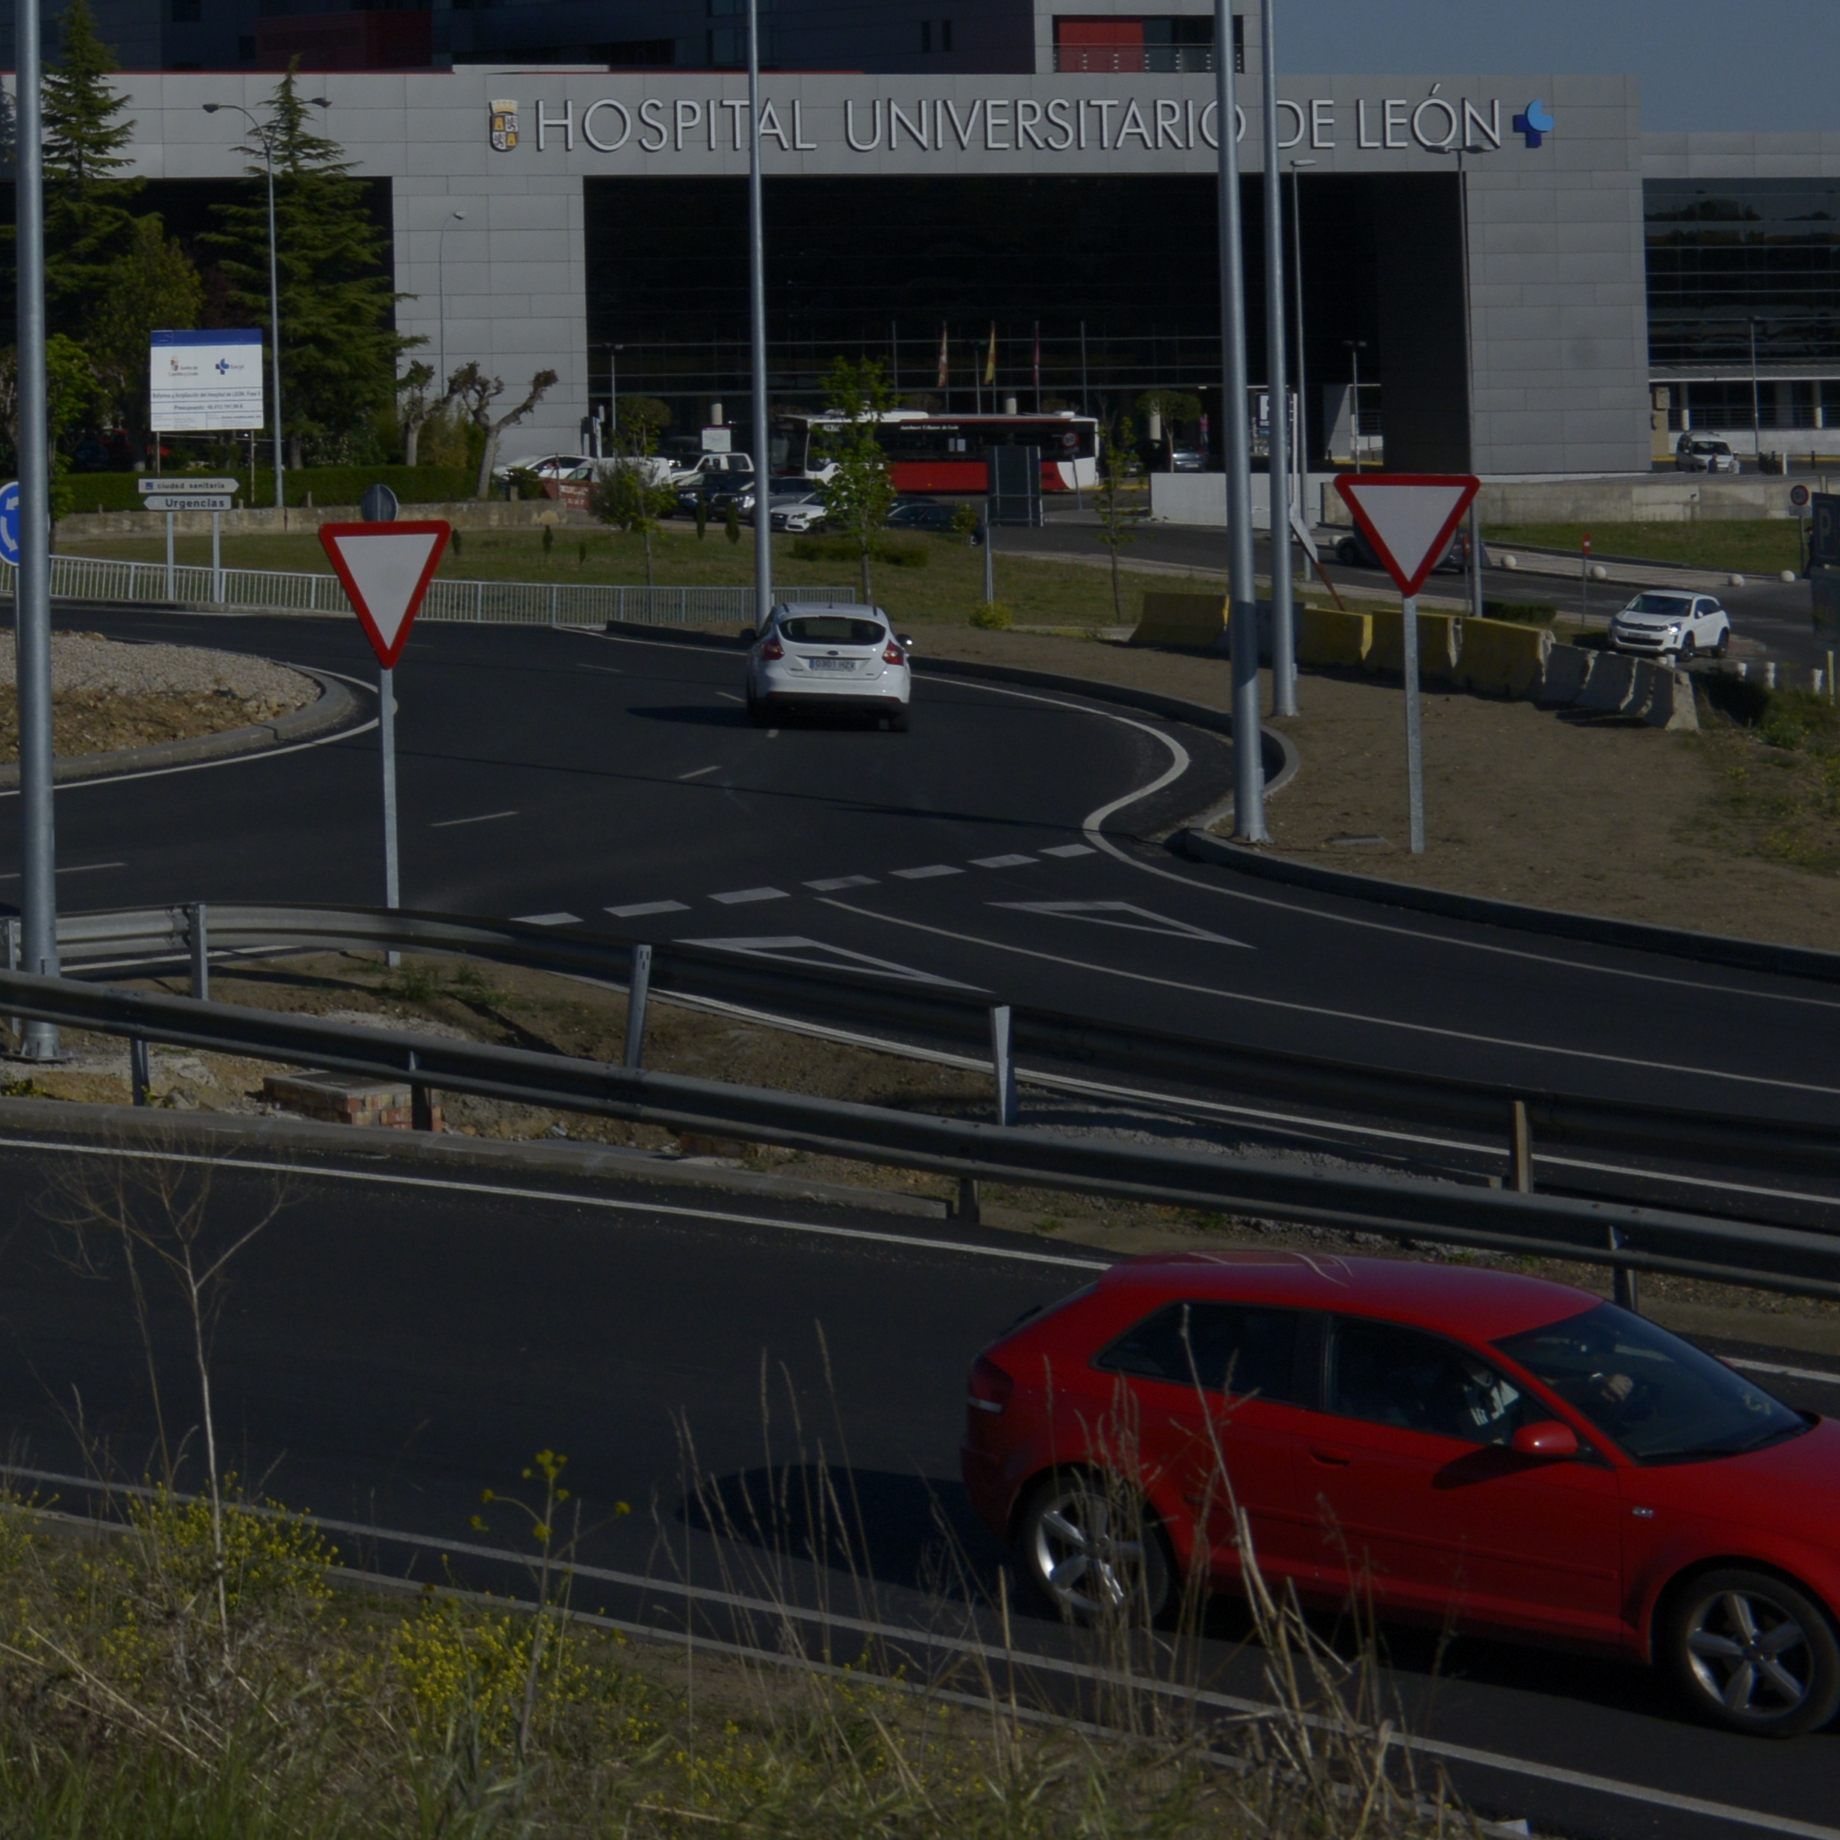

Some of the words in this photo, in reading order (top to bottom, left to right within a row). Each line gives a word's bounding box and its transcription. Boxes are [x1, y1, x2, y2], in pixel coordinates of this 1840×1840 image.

[536, 99, 817, 152] HOSPITAL
[845, 98, 1246, 151] UNIVERSITARIO
[1273, 99, 1335, 149] DE
[1357, 83, 1501, 149] LEÓN
[166, 498, 224, 509] Urgencias
